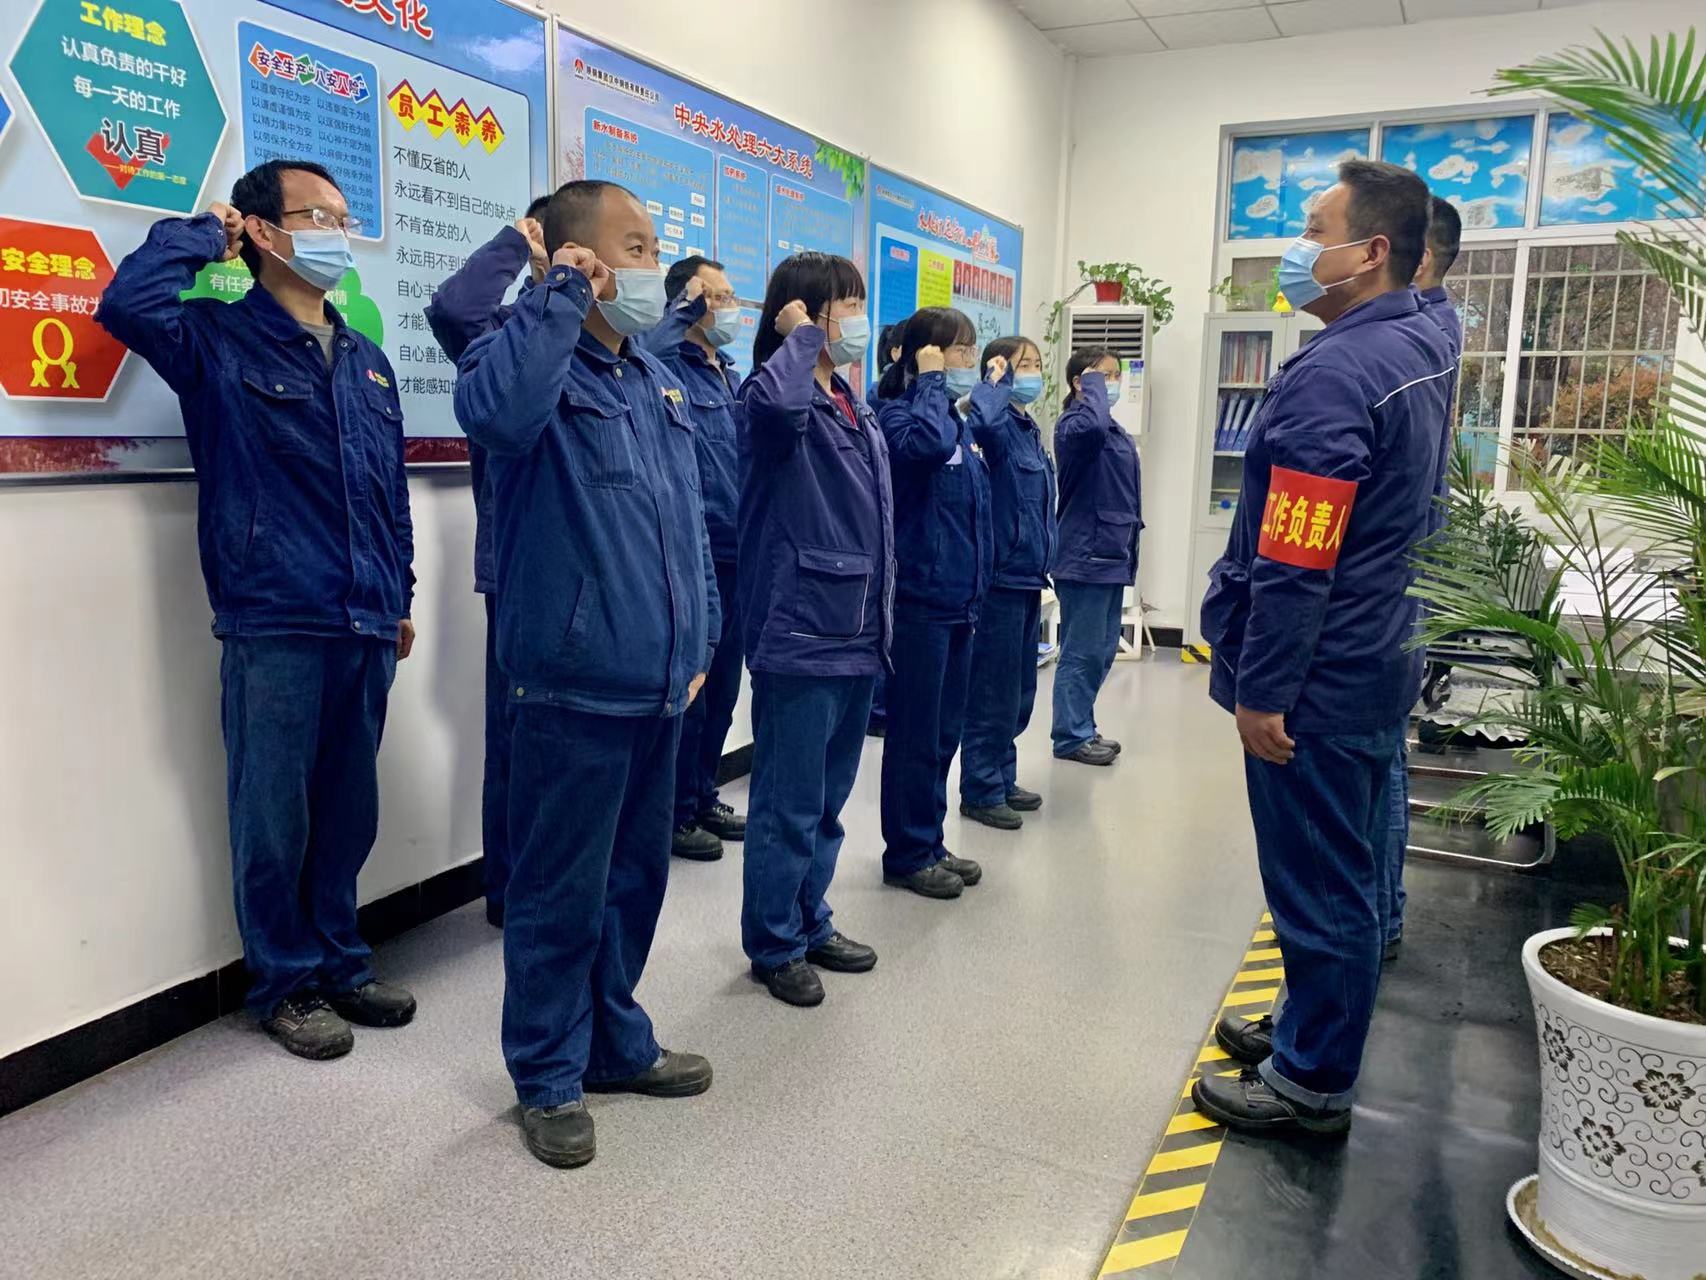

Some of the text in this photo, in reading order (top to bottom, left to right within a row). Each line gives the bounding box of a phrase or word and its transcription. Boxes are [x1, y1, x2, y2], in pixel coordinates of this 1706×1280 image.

[80, 1, 167, 46] 工作理念
[61, 35, 187, 88] 认真负责的干好
[74, 75, 180, 119] 每一天的工作
[398, 93, 497, 144] 员工素养
[101, 118, 165, 164] 认真
[674, 102, 814, 179] 中央水处理六大系统
[393, 146, 471, 181] 不懂反省的人
[394, 179, 517, 221] 永远看不到自己的缺点
[395, 213, 472, 243] 不肯奋发的人
[2, 247, 97, 280] 安全理念
[1262, 491, 1347, 551] 工作负责人
